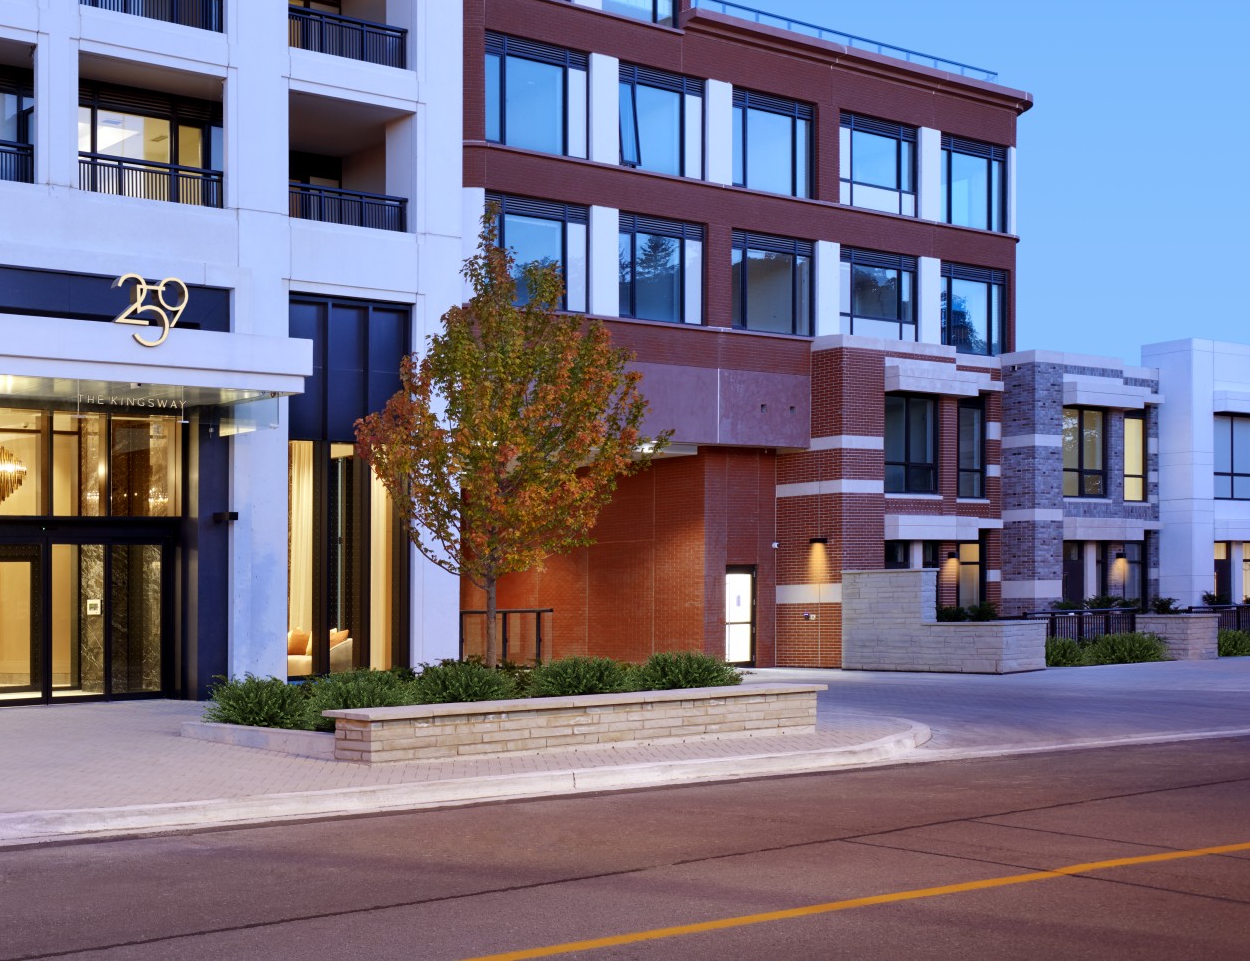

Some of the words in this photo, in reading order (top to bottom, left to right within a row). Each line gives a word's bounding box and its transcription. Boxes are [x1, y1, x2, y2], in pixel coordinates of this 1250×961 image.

[114, 272, 189, 347] 259
[78, 394, 104, 405] THE
[111, 395, 187, 409] KINGSWAY
